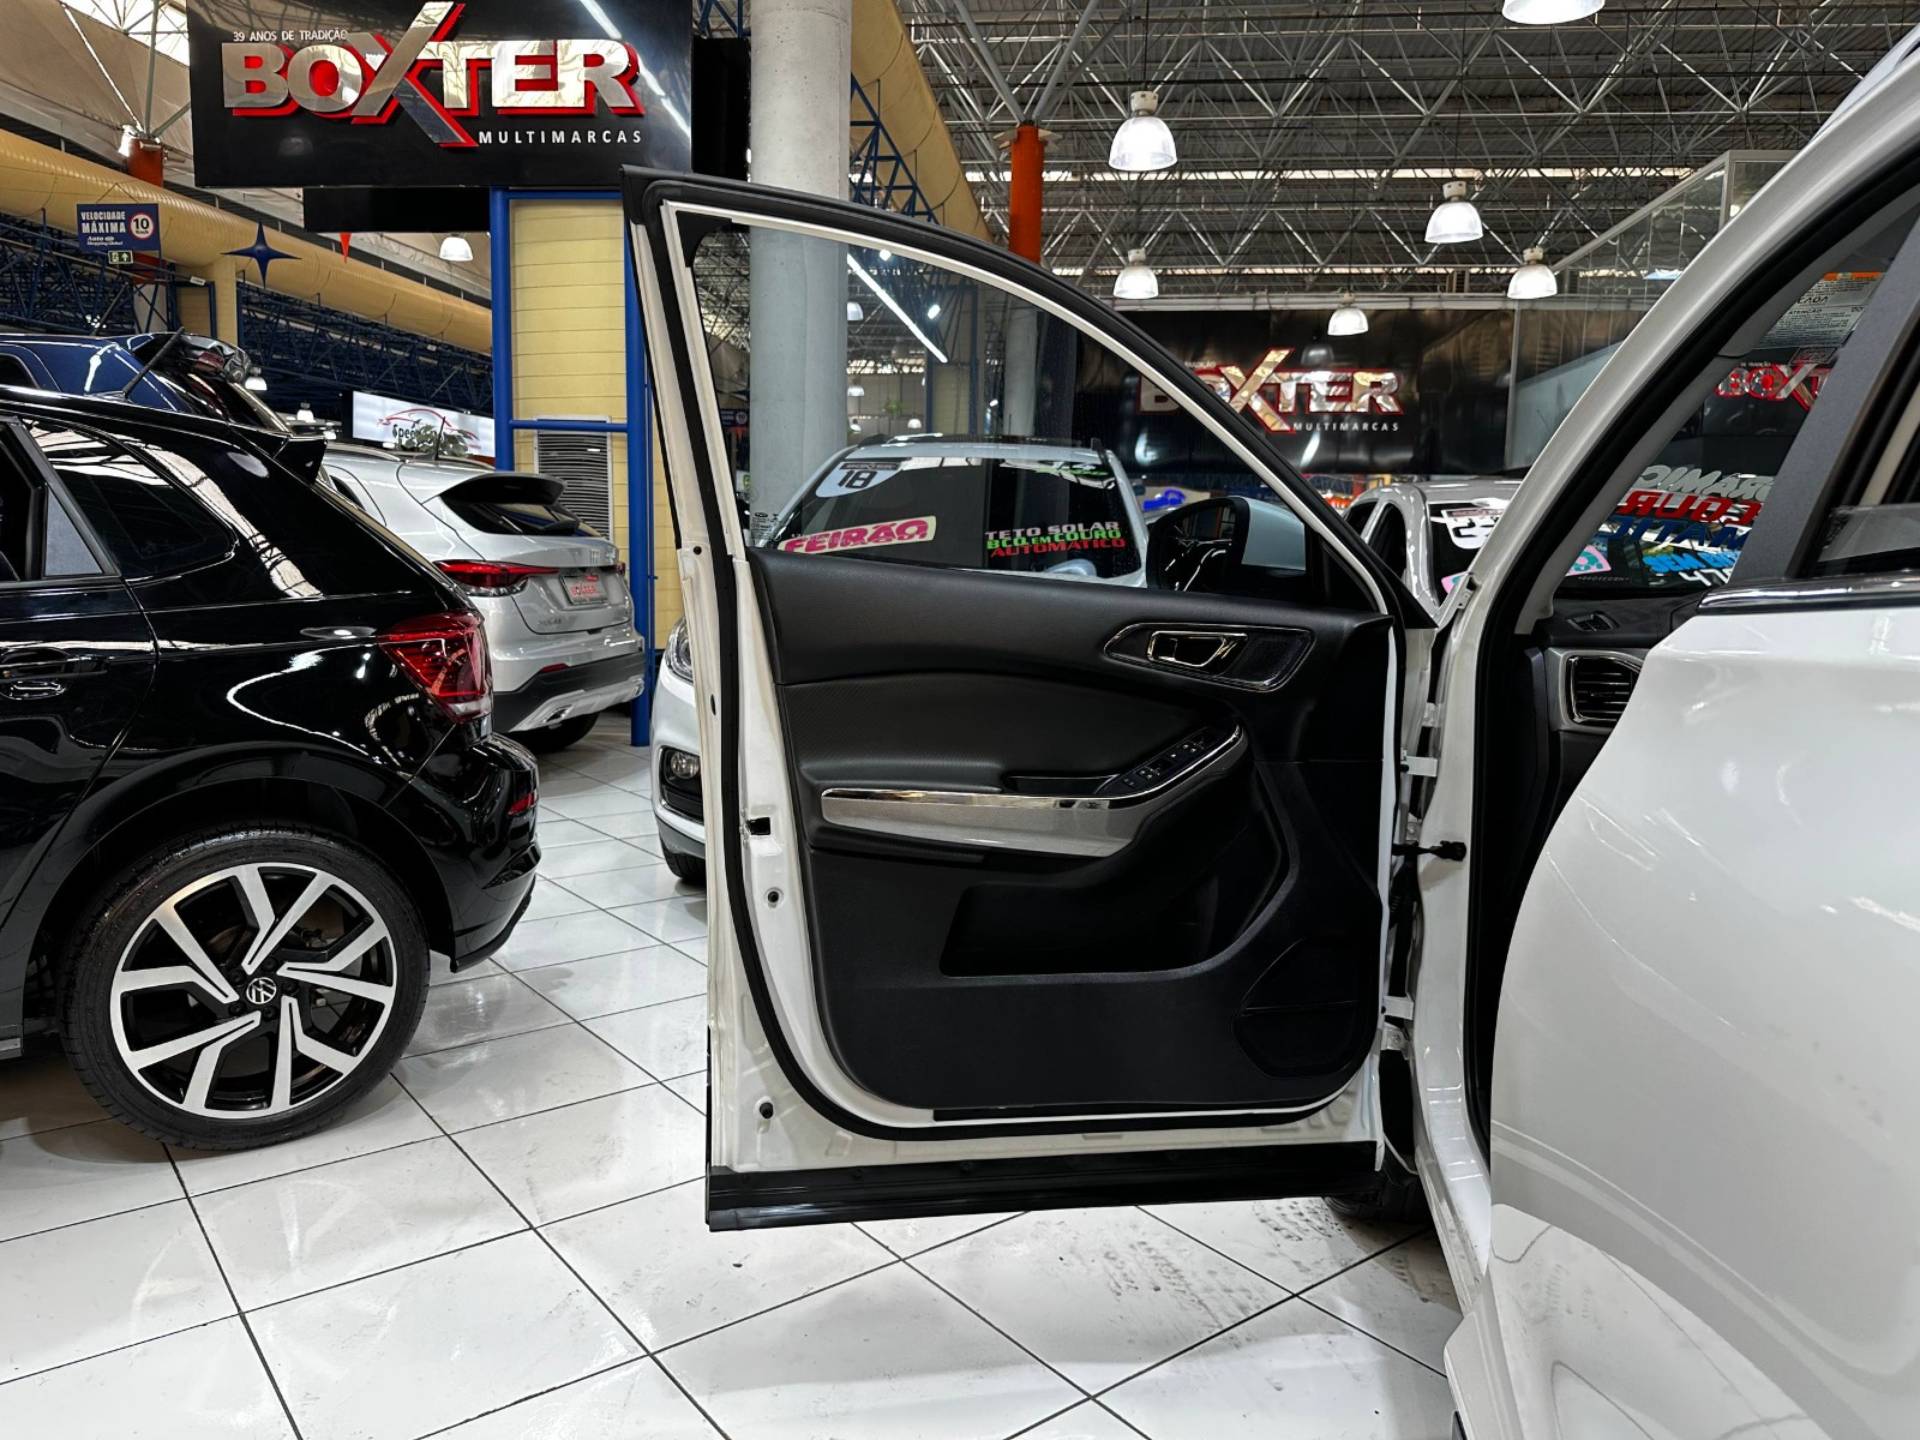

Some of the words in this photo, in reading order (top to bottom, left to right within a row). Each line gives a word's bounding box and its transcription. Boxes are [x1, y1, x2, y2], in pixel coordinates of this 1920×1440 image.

[233, 31, 245, 41] 39
[249, 31, 277, 41] ANOS
[281, 31, 294, 40] DE
[299, 28, 349, 42] TRADIÇÃO
[221, 1, 640, 147] BOXTER
[479, 129, 642, 144] MULTIMARCAS
[81, 211, 126, 220] VELOCIDADE
[82, 220, 126, 233] MÁXIMA
[133, 218, 149, 229] 10
[1294, 422, 1399, 432] MULTIMARCAS
[837, 470, 878, 489] 18
[784, 519, 929, 552] FEIRÃO
[985, 527, 1041, 541] TETO
[1047, 521, 1120, 534] SOLAR
[1031, 535, 1050, 544] EM
[1054, 529, 1121, 543] COURO
